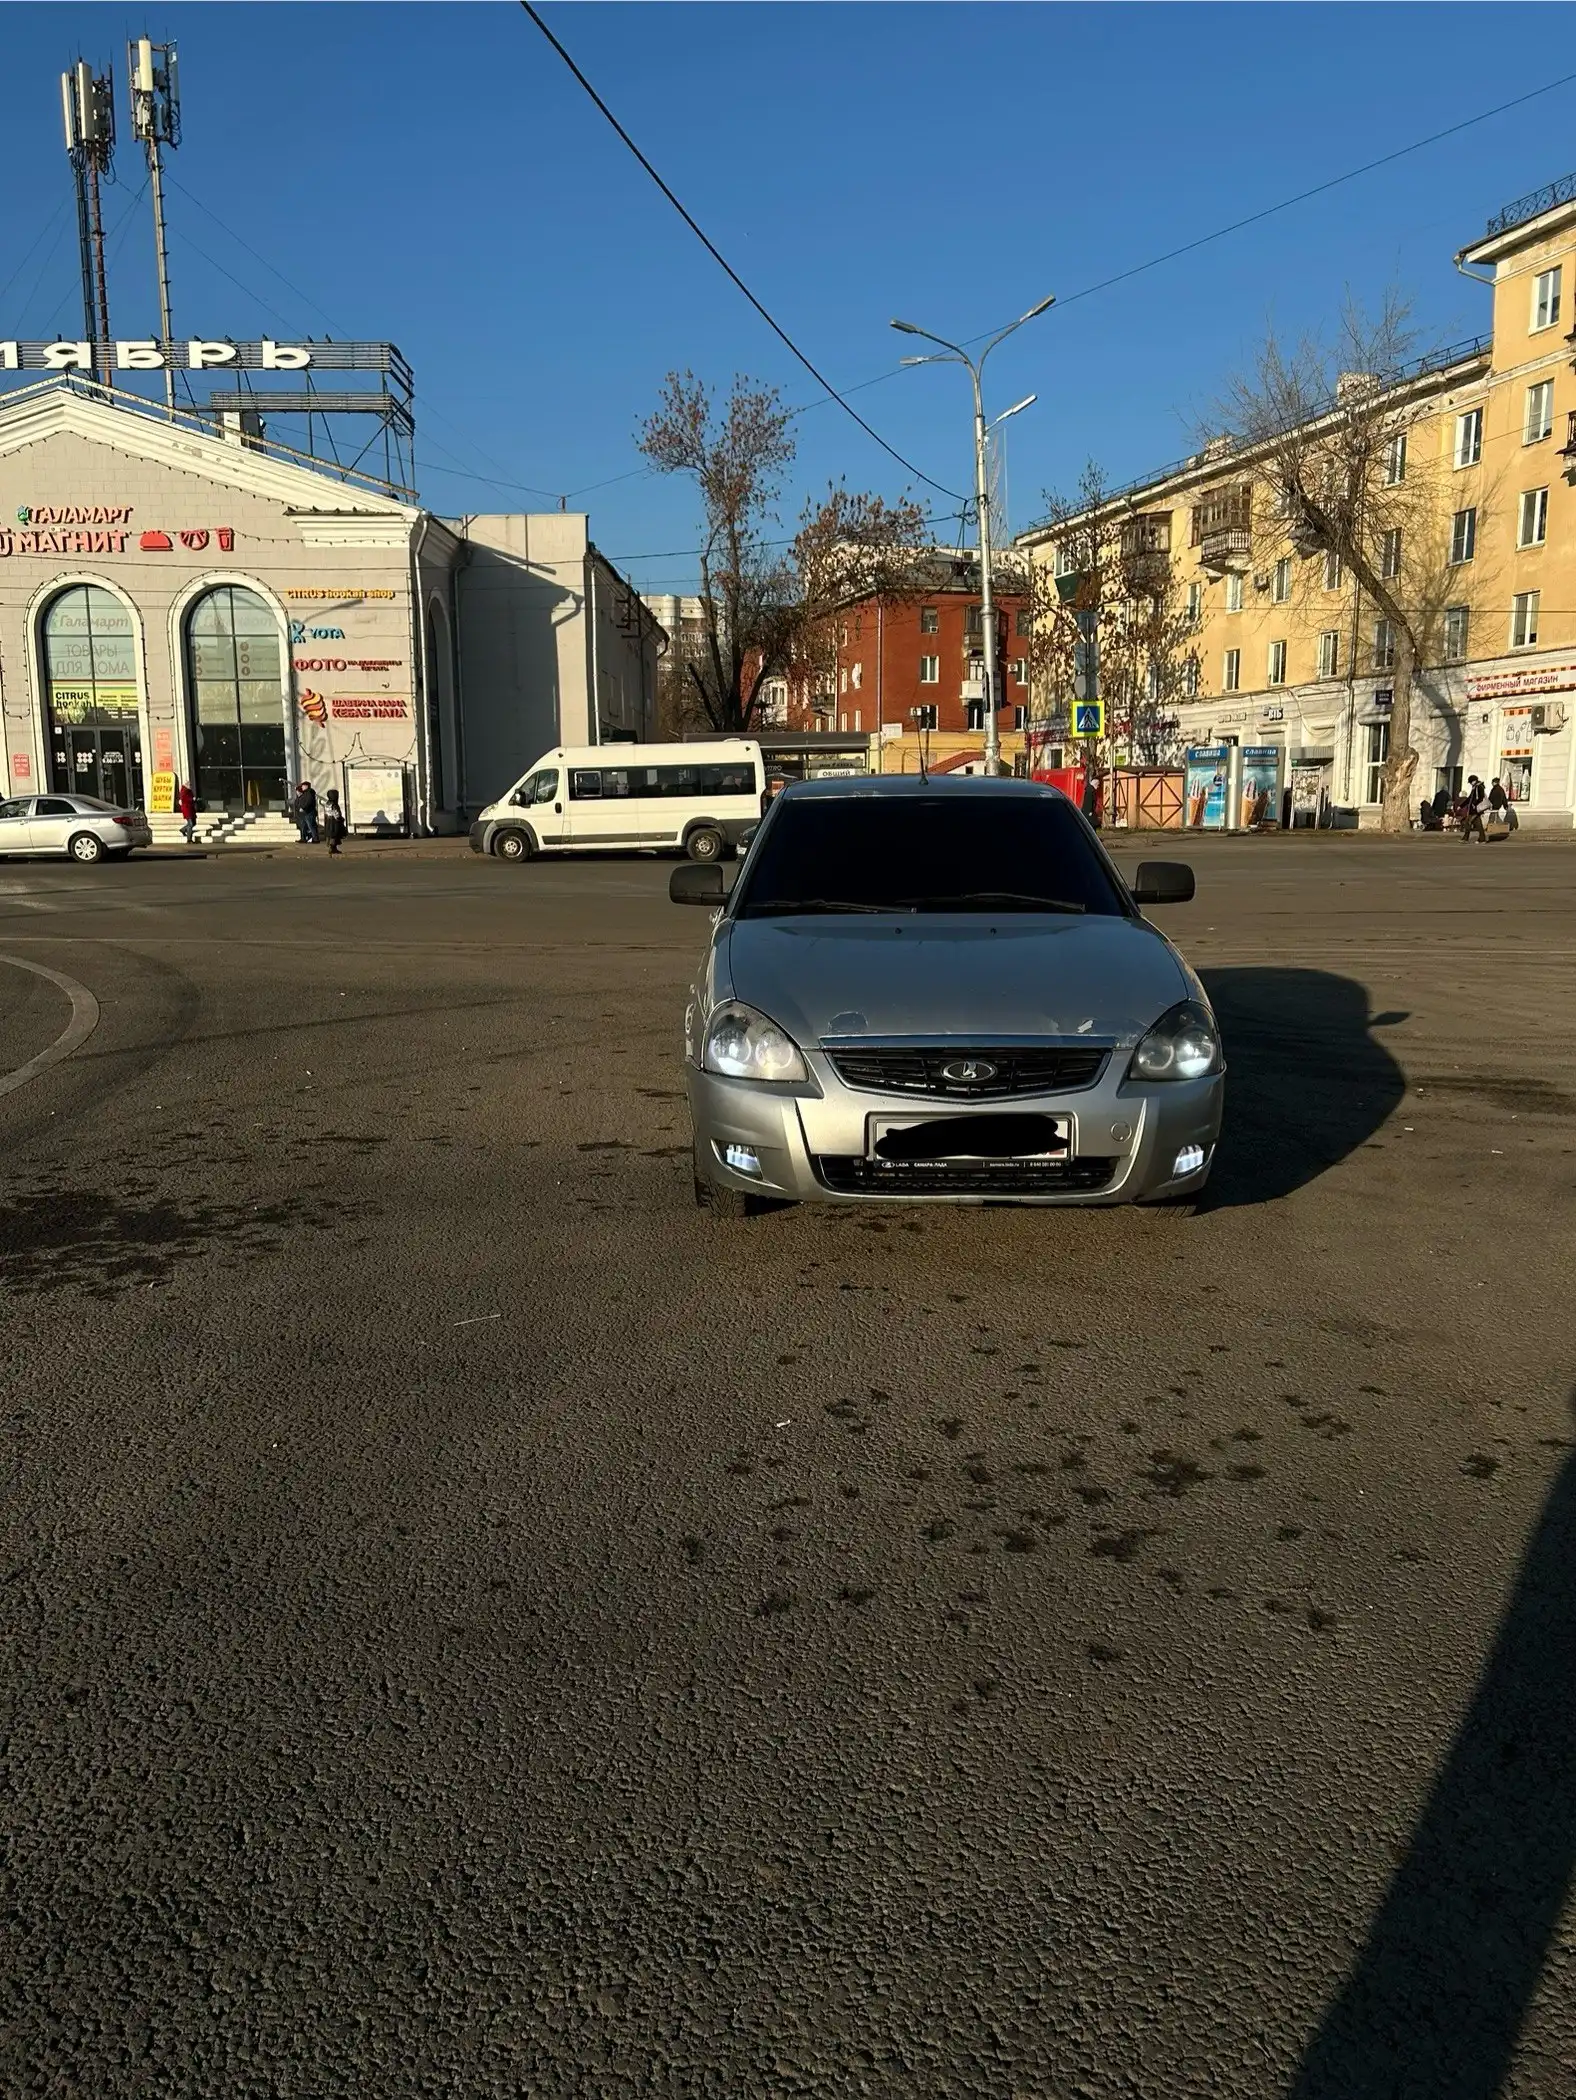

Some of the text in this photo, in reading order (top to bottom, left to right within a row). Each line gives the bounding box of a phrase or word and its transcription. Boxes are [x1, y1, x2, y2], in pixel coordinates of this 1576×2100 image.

[15, 530, 130, 553] МАГНИТ
[65, 644, 118, 657] ТОВАРЫ
[56, 661, 83, 676] ДЛЯ
[294, 658, 347, 672] ФОТО
[1476, 675, 1559, 692] ФИРМЕННЫЙ МАГАЗИН
[56, 692, 90, 700] CITRUS
